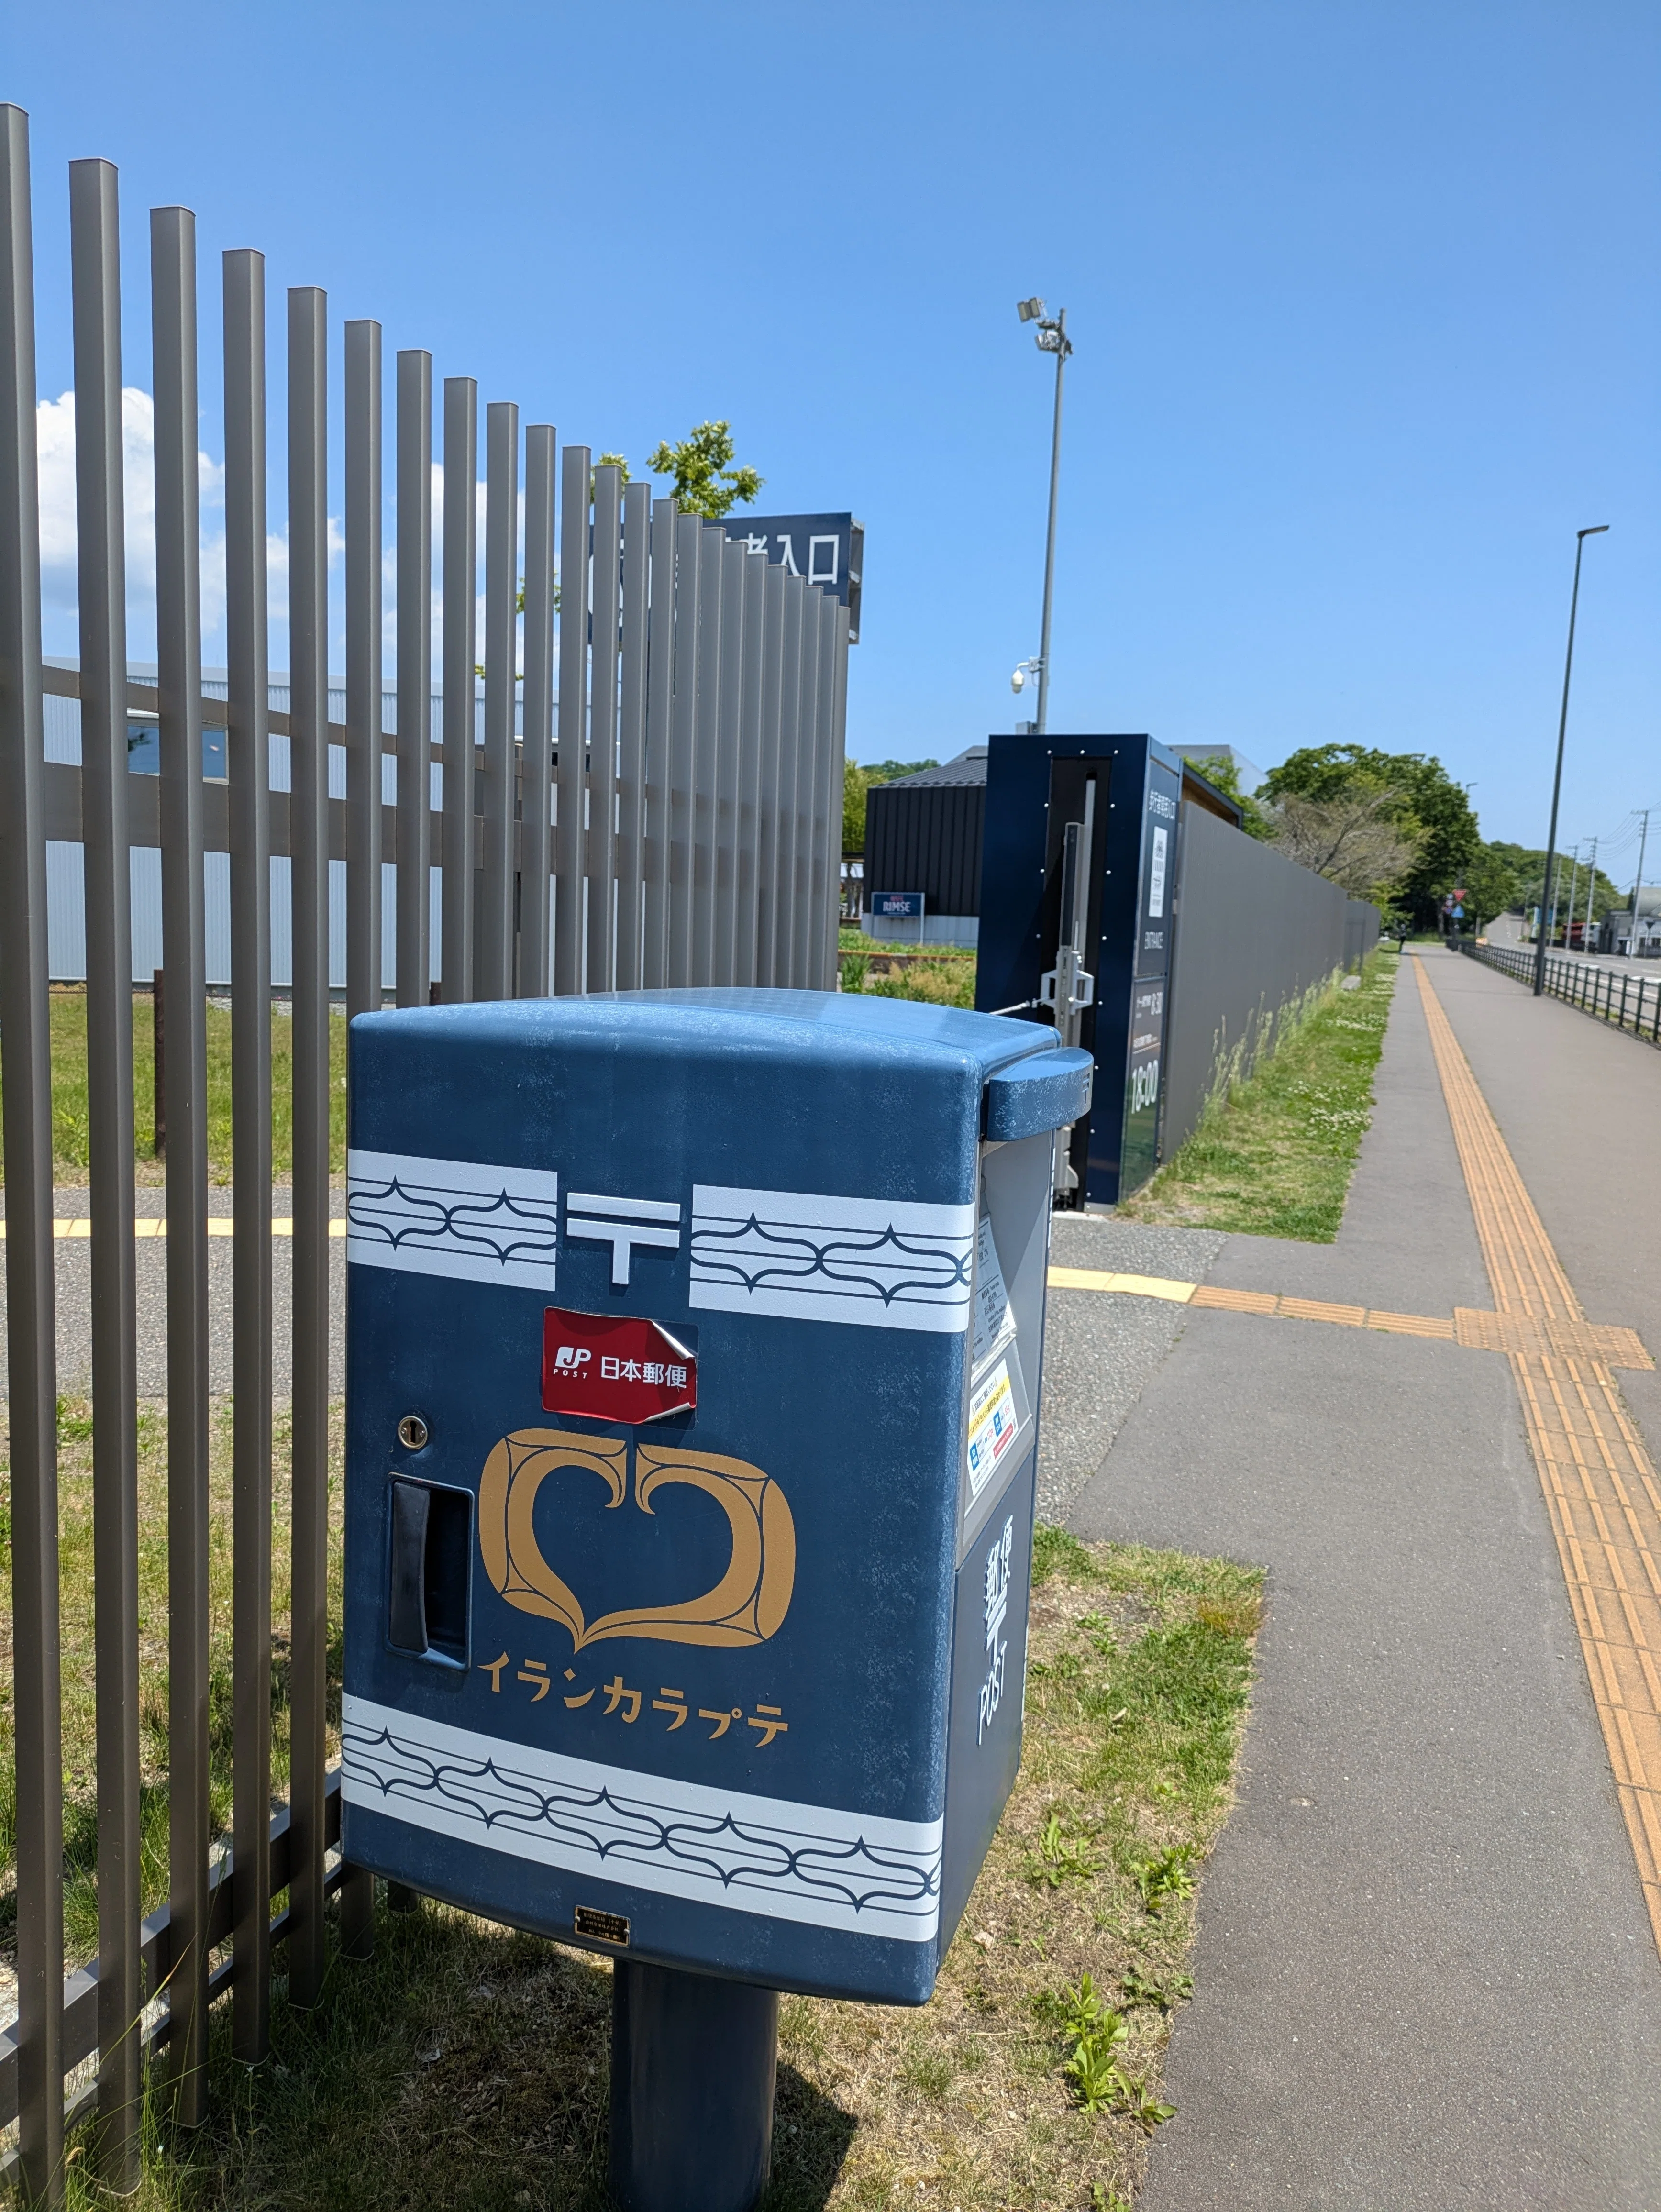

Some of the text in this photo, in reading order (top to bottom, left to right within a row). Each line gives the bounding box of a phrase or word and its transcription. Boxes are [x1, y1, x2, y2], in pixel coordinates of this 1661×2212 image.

[1131, 1060, 1158, 1114] 18:00
[553, 1369, 588, 1379] POST
[601, 1356, 687, 1388] 日本郵便
[986, 1515, 1013, 1621] 郵便
[477, 1651, 788, 1748] イランカラプテ
[979, 1640, 1007, 1746] POST
